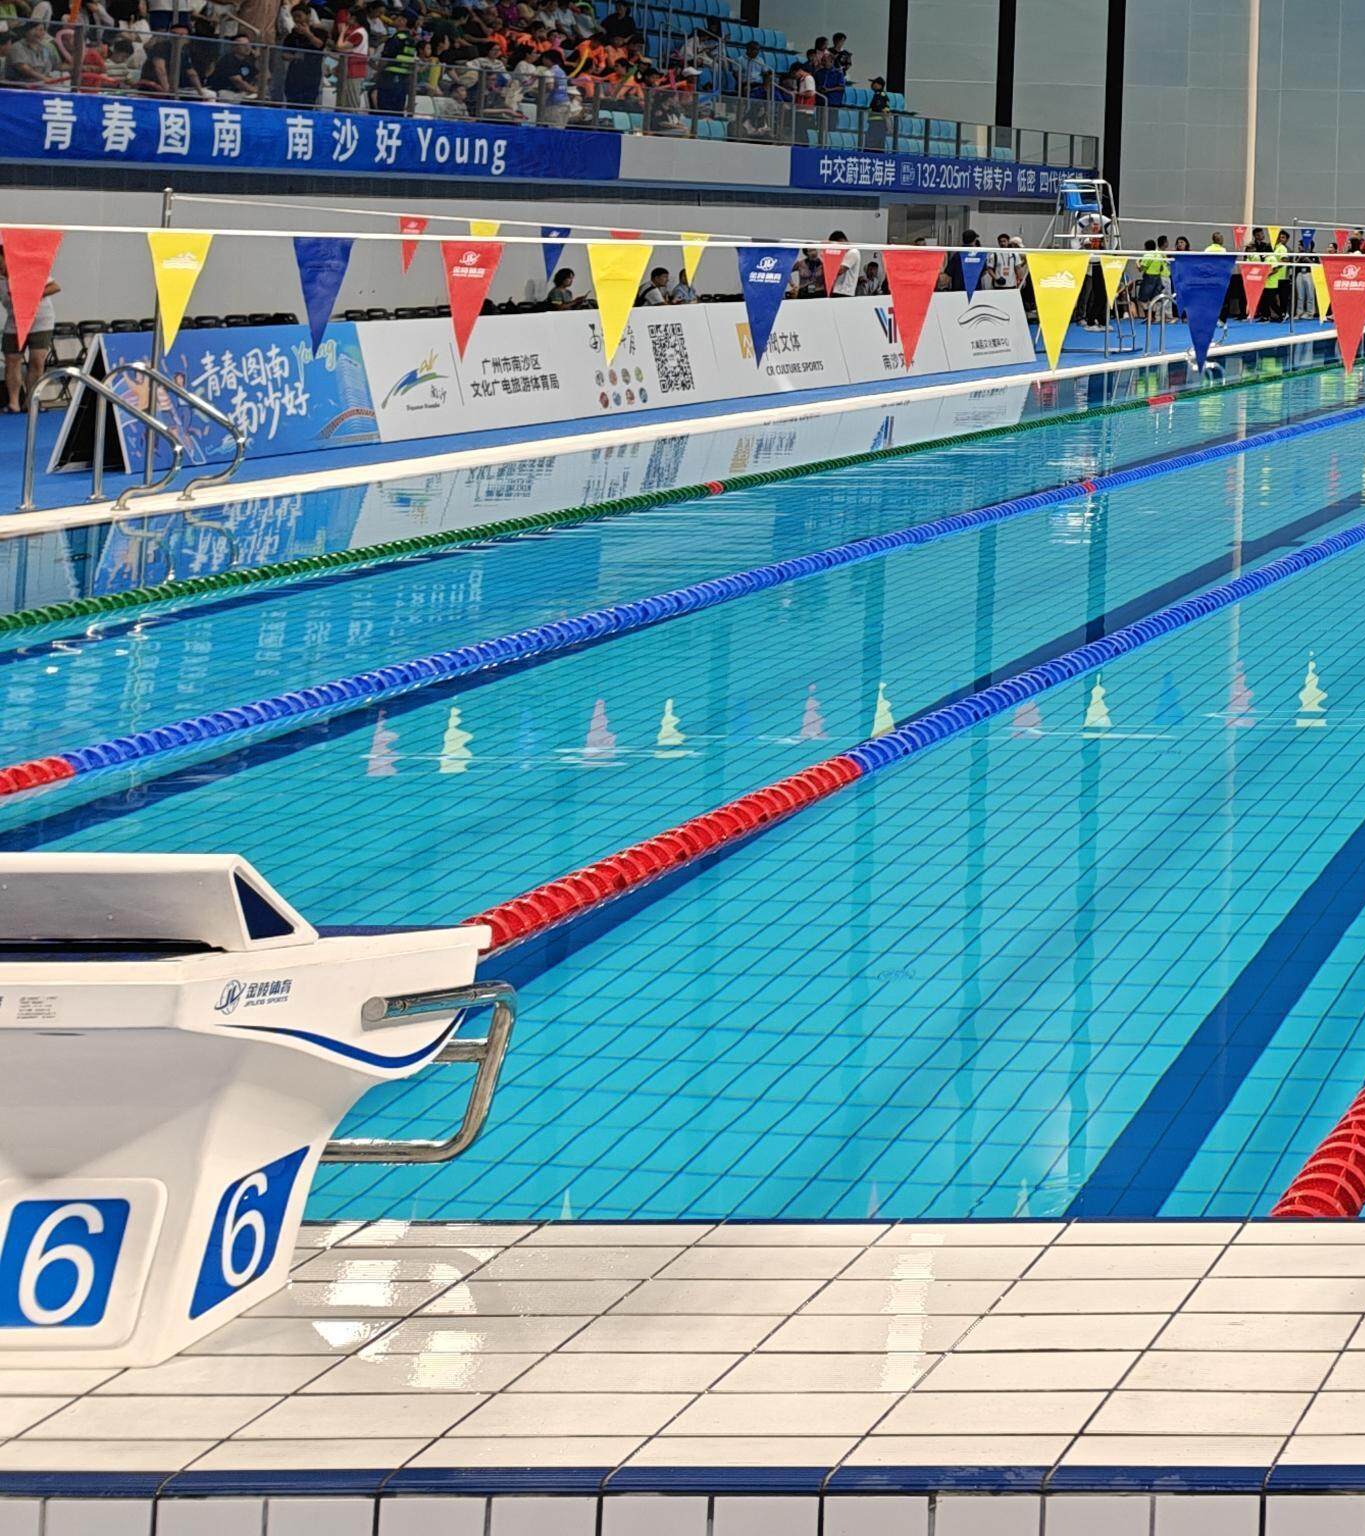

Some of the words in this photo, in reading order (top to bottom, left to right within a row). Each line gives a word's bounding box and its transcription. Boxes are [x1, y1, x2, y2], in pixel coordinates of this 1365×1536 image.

[41, 97, 243, 158] 青春图南
[820, 155, 896, 186] 中交蔚蓝海岸
[973, 165, 1013, 192] 专梯专户
[1017, 169, 1037, 193] 低密
[764, 331, 802, 356] 润文体
[191, 344, 290, 401] 青春图南
[482, 353, 542, 375] 广州市南沙区
[776, 362, 801, 376] CULTURE
[801, 360, 824, 373] SPORTS
[470, 373, 560, 398] 文化广电旅游体育局
[228, 381, 310, 440] 南沙好
[245, 978, 293, 1000] 金陵体育
[221, 1171, 268, 1288] 6
[18, 1203, 105, 1325] 6
